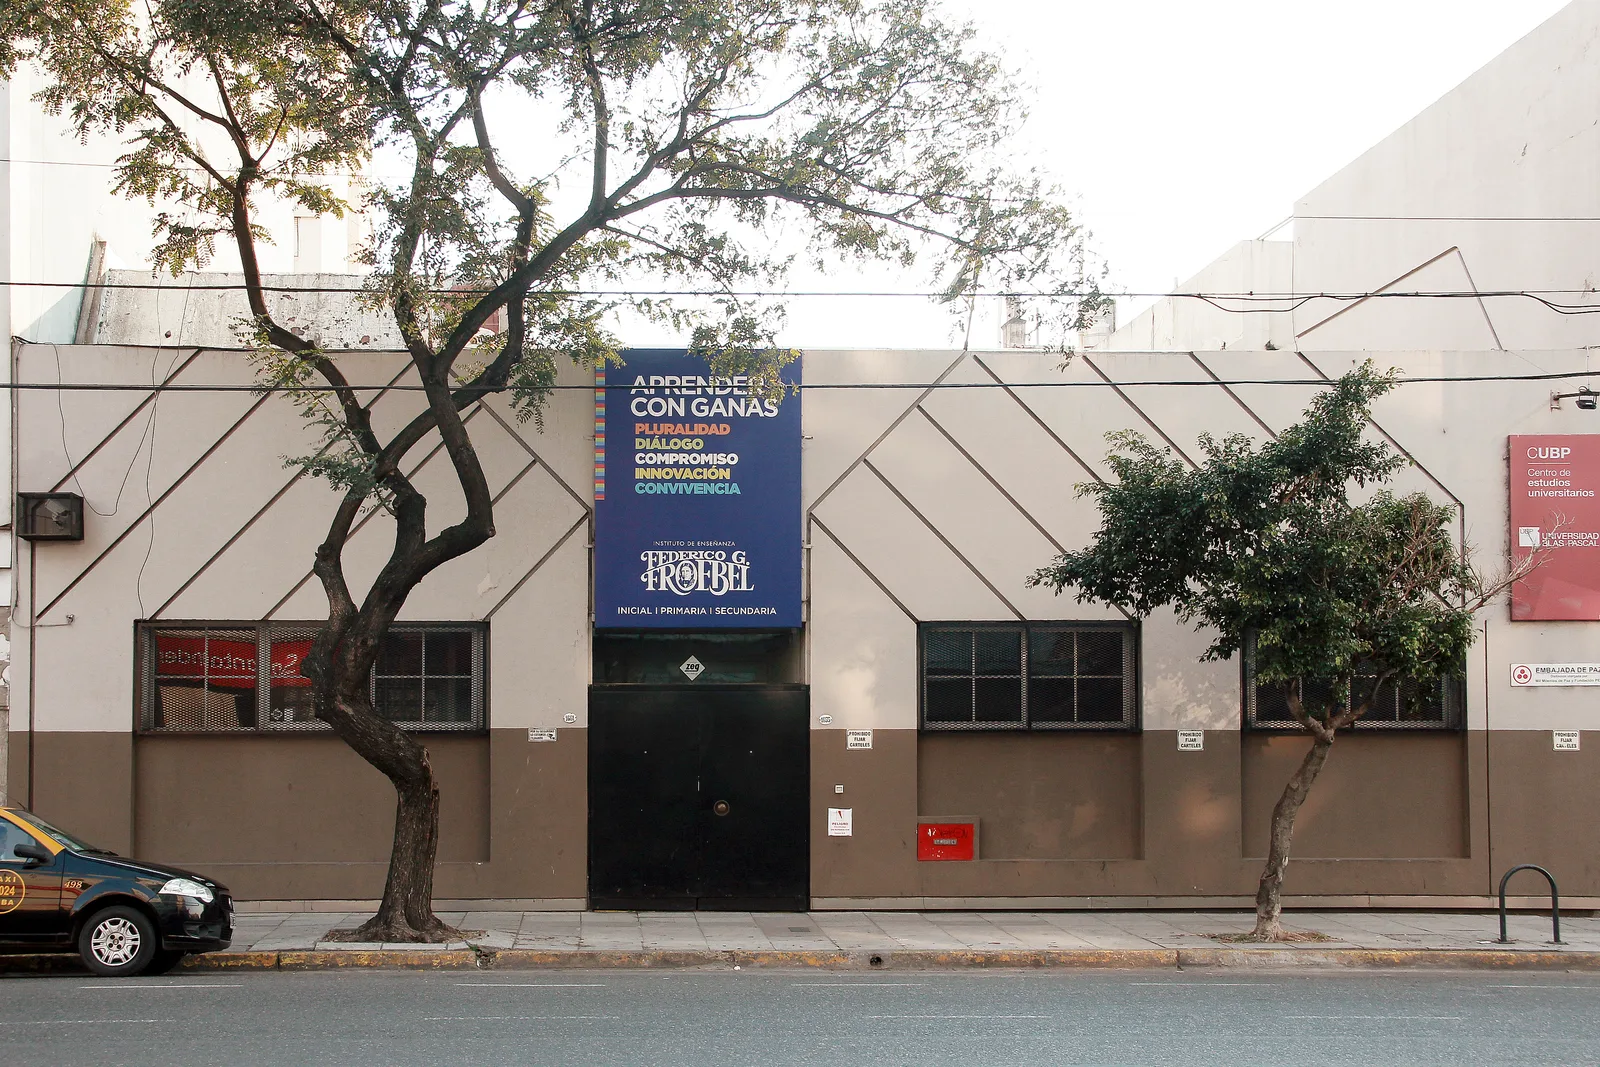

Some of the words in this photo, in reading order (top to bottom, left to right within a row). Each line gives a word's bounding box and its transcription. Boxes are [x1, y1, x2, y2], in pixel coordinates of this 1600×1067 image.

[630, 397, 685, 417] CON
[690, 397, 779, 417] GANAS
[635, 423, 731, 435] PLURALIDAD
[635, 435, 704, 450] DIÁLOGO
[1527, 446, 1571, 459] CUBP
[635, 453, 739, 465] COMPROMISO
[635, 465, 731, 480] INNOVACIÓN
[1527, 468, 1558, 477] Centro
[1559, 468, 1571, 477] de
[635, 482, 741, 495] CONVIVENCIA
[1527, 478, 1571, 487] estudios
[1528, 488, 1595, 498] universitarios
[1541, 532, 1600, 540] UNIVERSIDAD
[697, 539, 736, 547] ENSEÑANZA
[640, 550, 727, 571] FEDERICO
[640, 559, 755, 596] FROEBEL
[617, 606, 653, 615] INICIAL
[660, 606, 707, 615] PRIMARIA
[715, 606, 777, 615] SECUNDARIA
